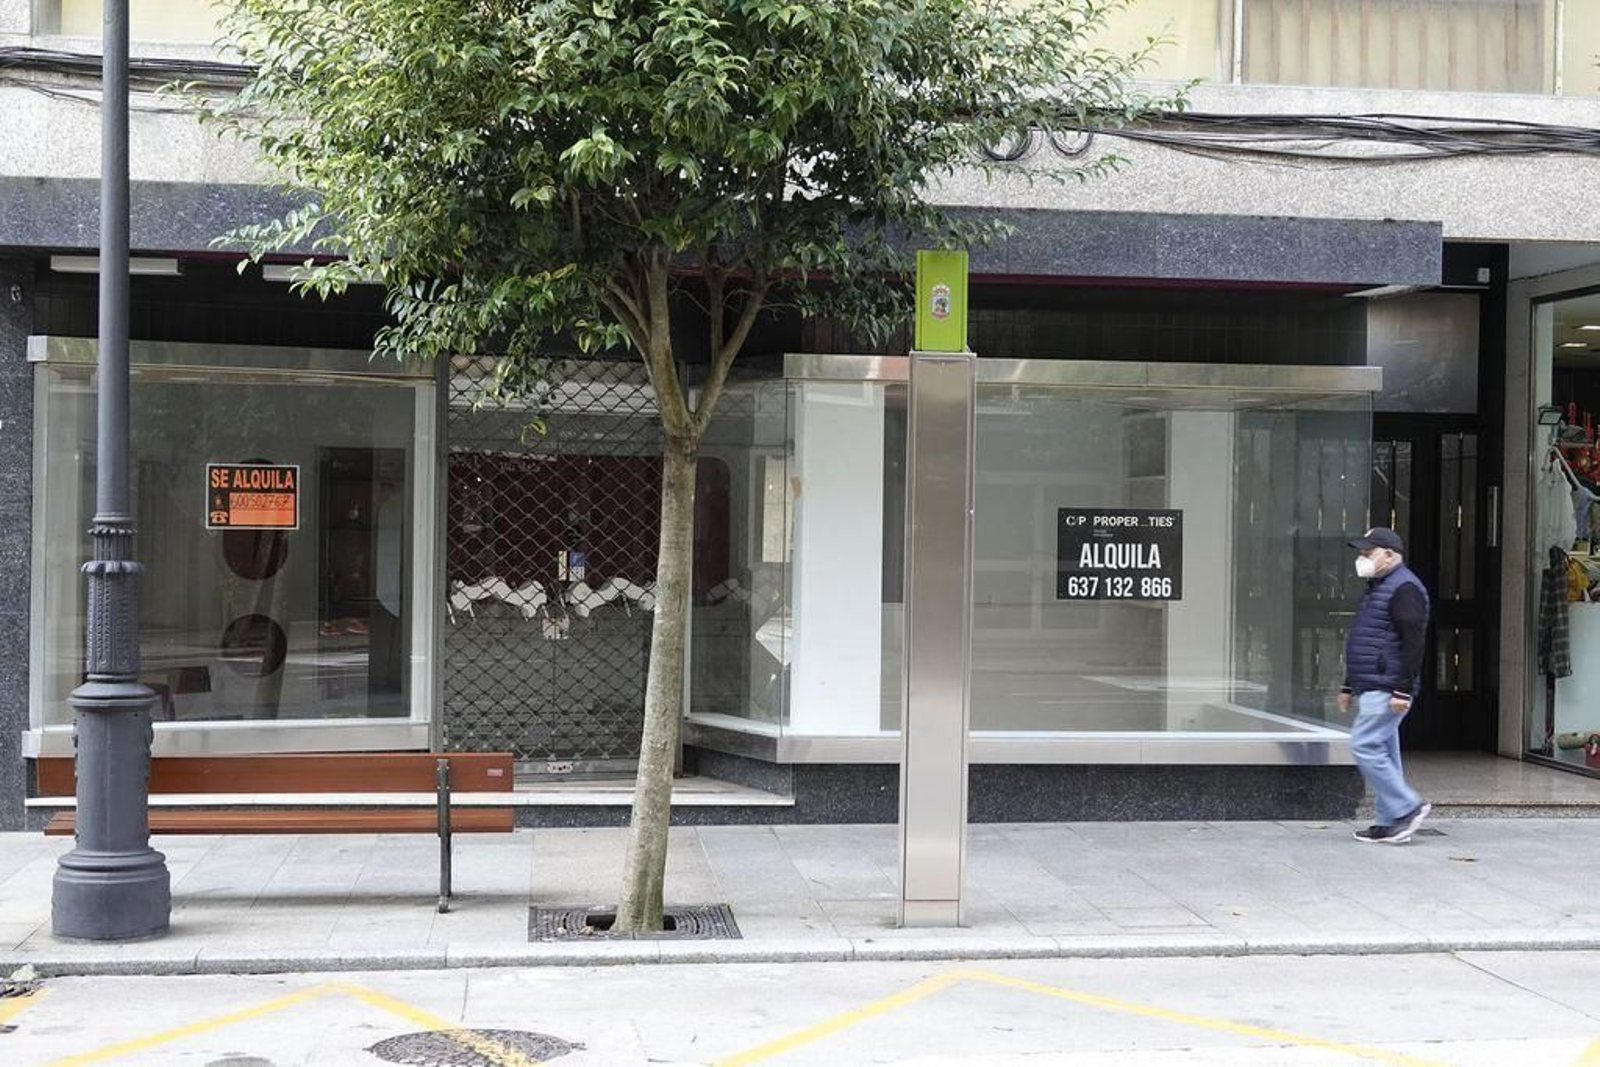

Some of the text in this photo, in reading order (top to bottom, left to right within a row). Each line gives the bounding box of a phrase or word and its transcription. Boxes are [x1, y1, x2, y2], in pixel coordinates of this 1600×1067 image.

[211, 468, 294, 489] SE ALQUILA
[1079, 543, 1161, 569] ALQUILA
[1068, 577, 1172, 597] 637 132 866
